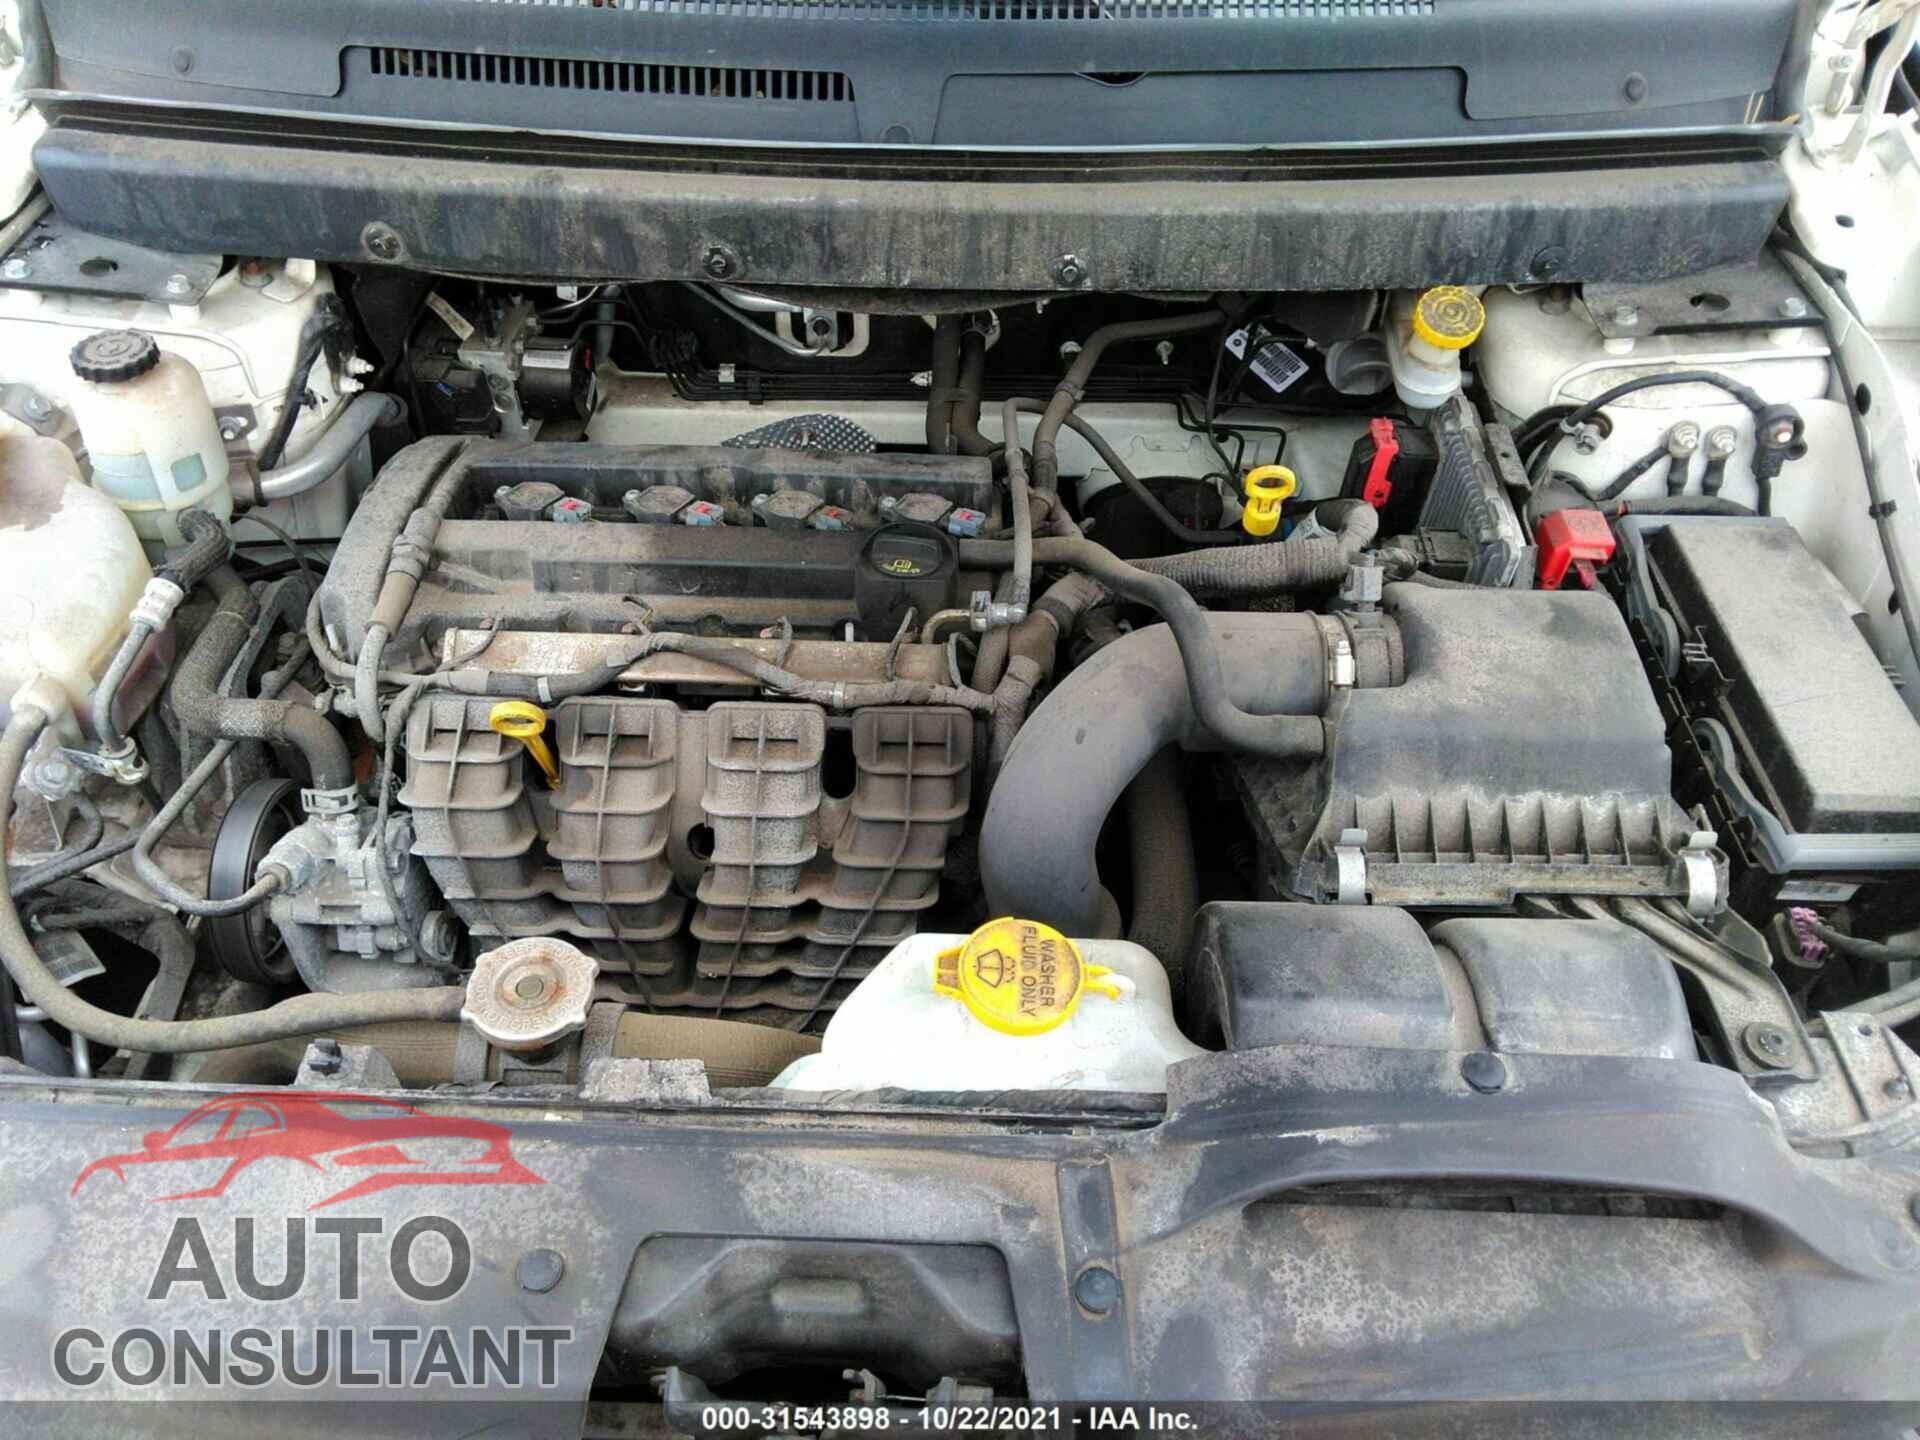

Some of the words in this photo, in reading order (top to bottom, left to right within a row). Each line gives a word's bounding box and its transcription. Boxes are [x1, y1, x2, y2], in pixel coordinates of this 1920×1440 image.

[1020, 926, 1037, 971] FLUID
[1020, 975, 1036, 1017] ONLY
[1040, 939, 1056, 1008] WASHER
